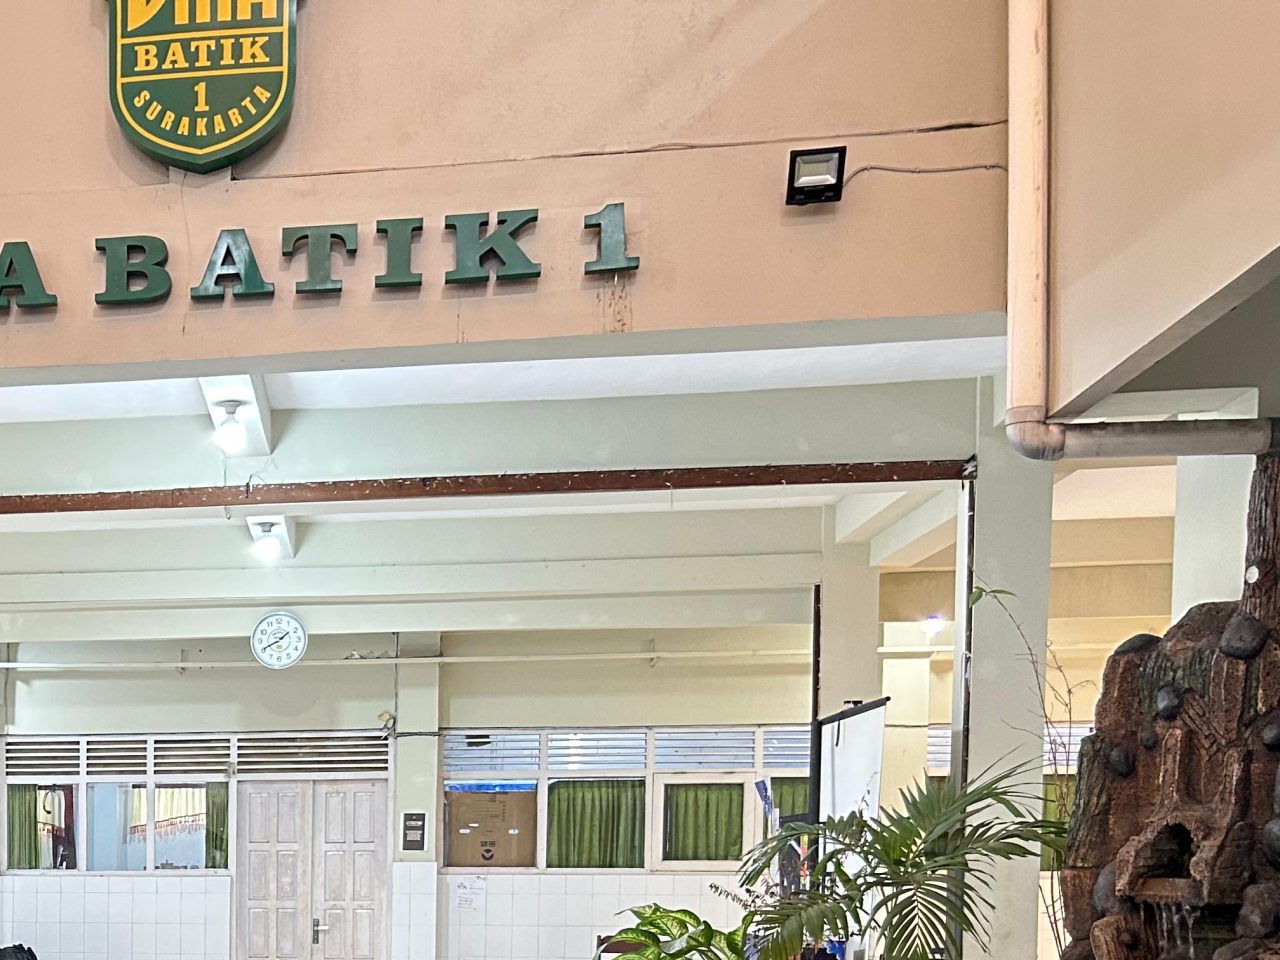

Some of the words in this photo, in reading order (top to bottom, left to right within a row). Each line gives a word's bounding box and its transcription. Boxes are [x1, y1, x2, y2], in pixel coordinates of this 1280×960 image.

[134, 36, 270, 71] BATIK
[133, 84, 272, 136] SURAKARTA
[194, 82, 209, 112] 1
[95, 208, 541, 305] BATIK
[584, 202, 640, 276] 1
